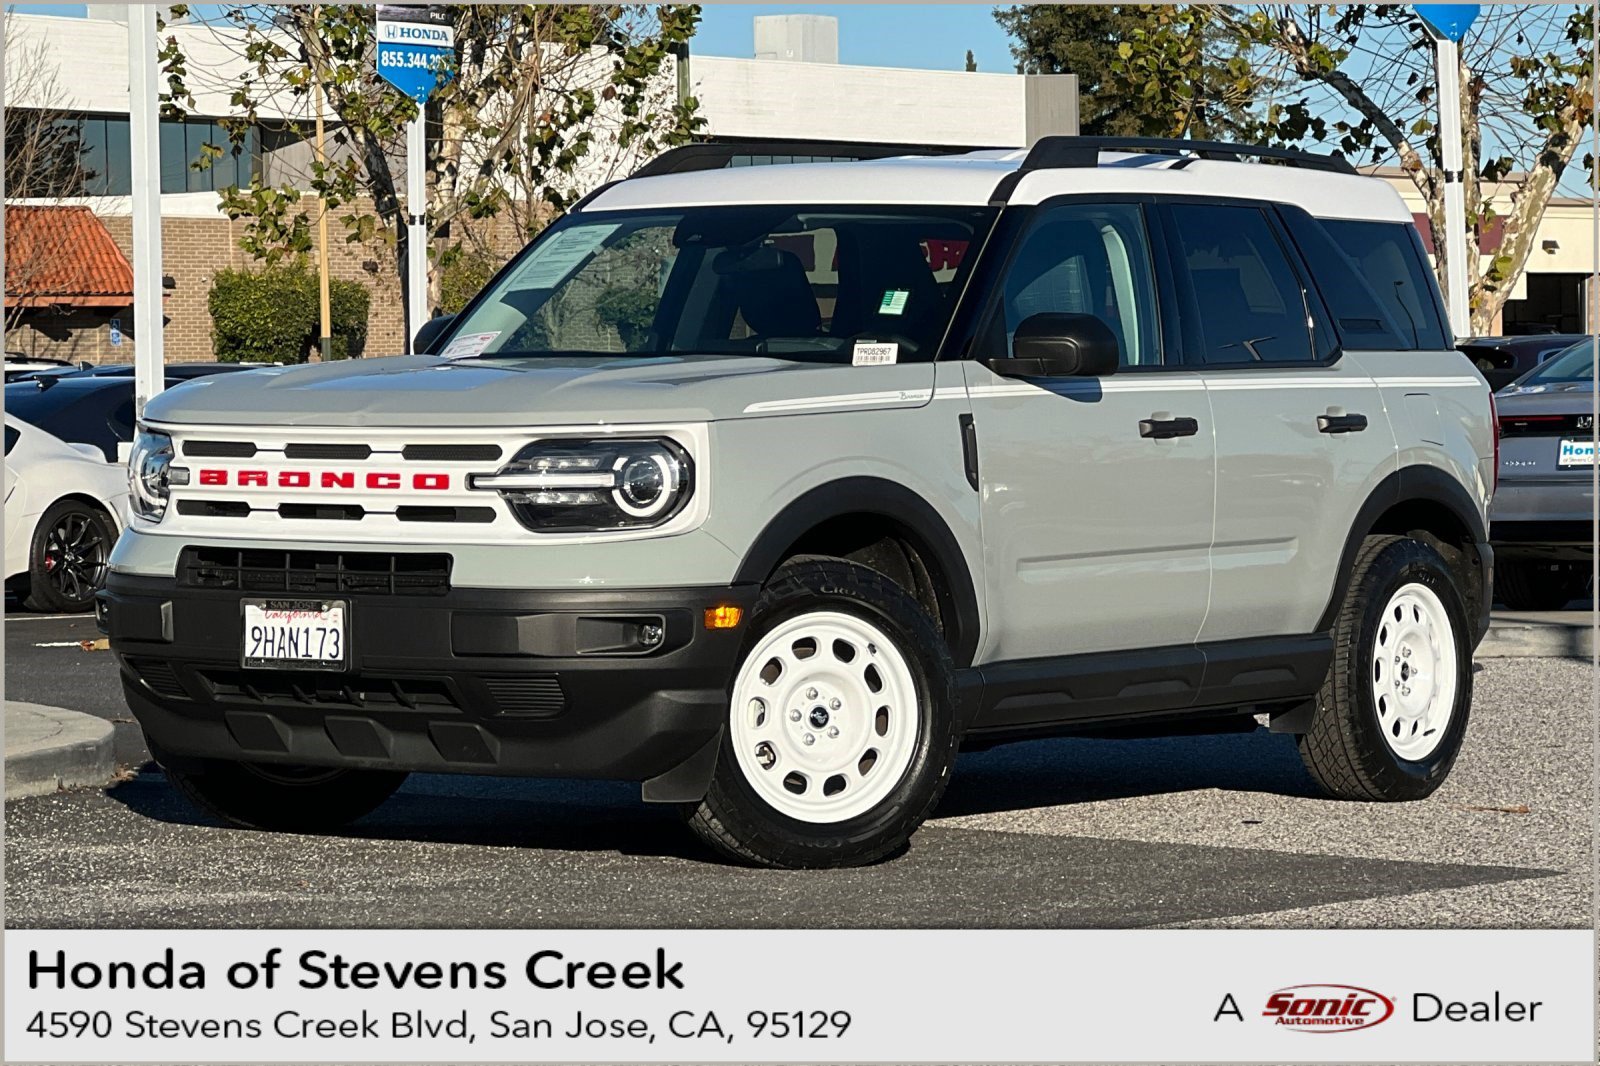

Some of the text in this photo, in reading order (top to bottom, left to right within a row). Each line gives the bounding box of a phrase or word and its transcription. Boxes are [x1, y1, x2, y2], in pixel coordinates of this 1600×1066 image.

[400, 27, 448, 41] HONDA
[199, 469, 450, 490] BRONCO
[293, 601, 317, 609] JOSE
[250, 626, 340, 659] 9HAN173
